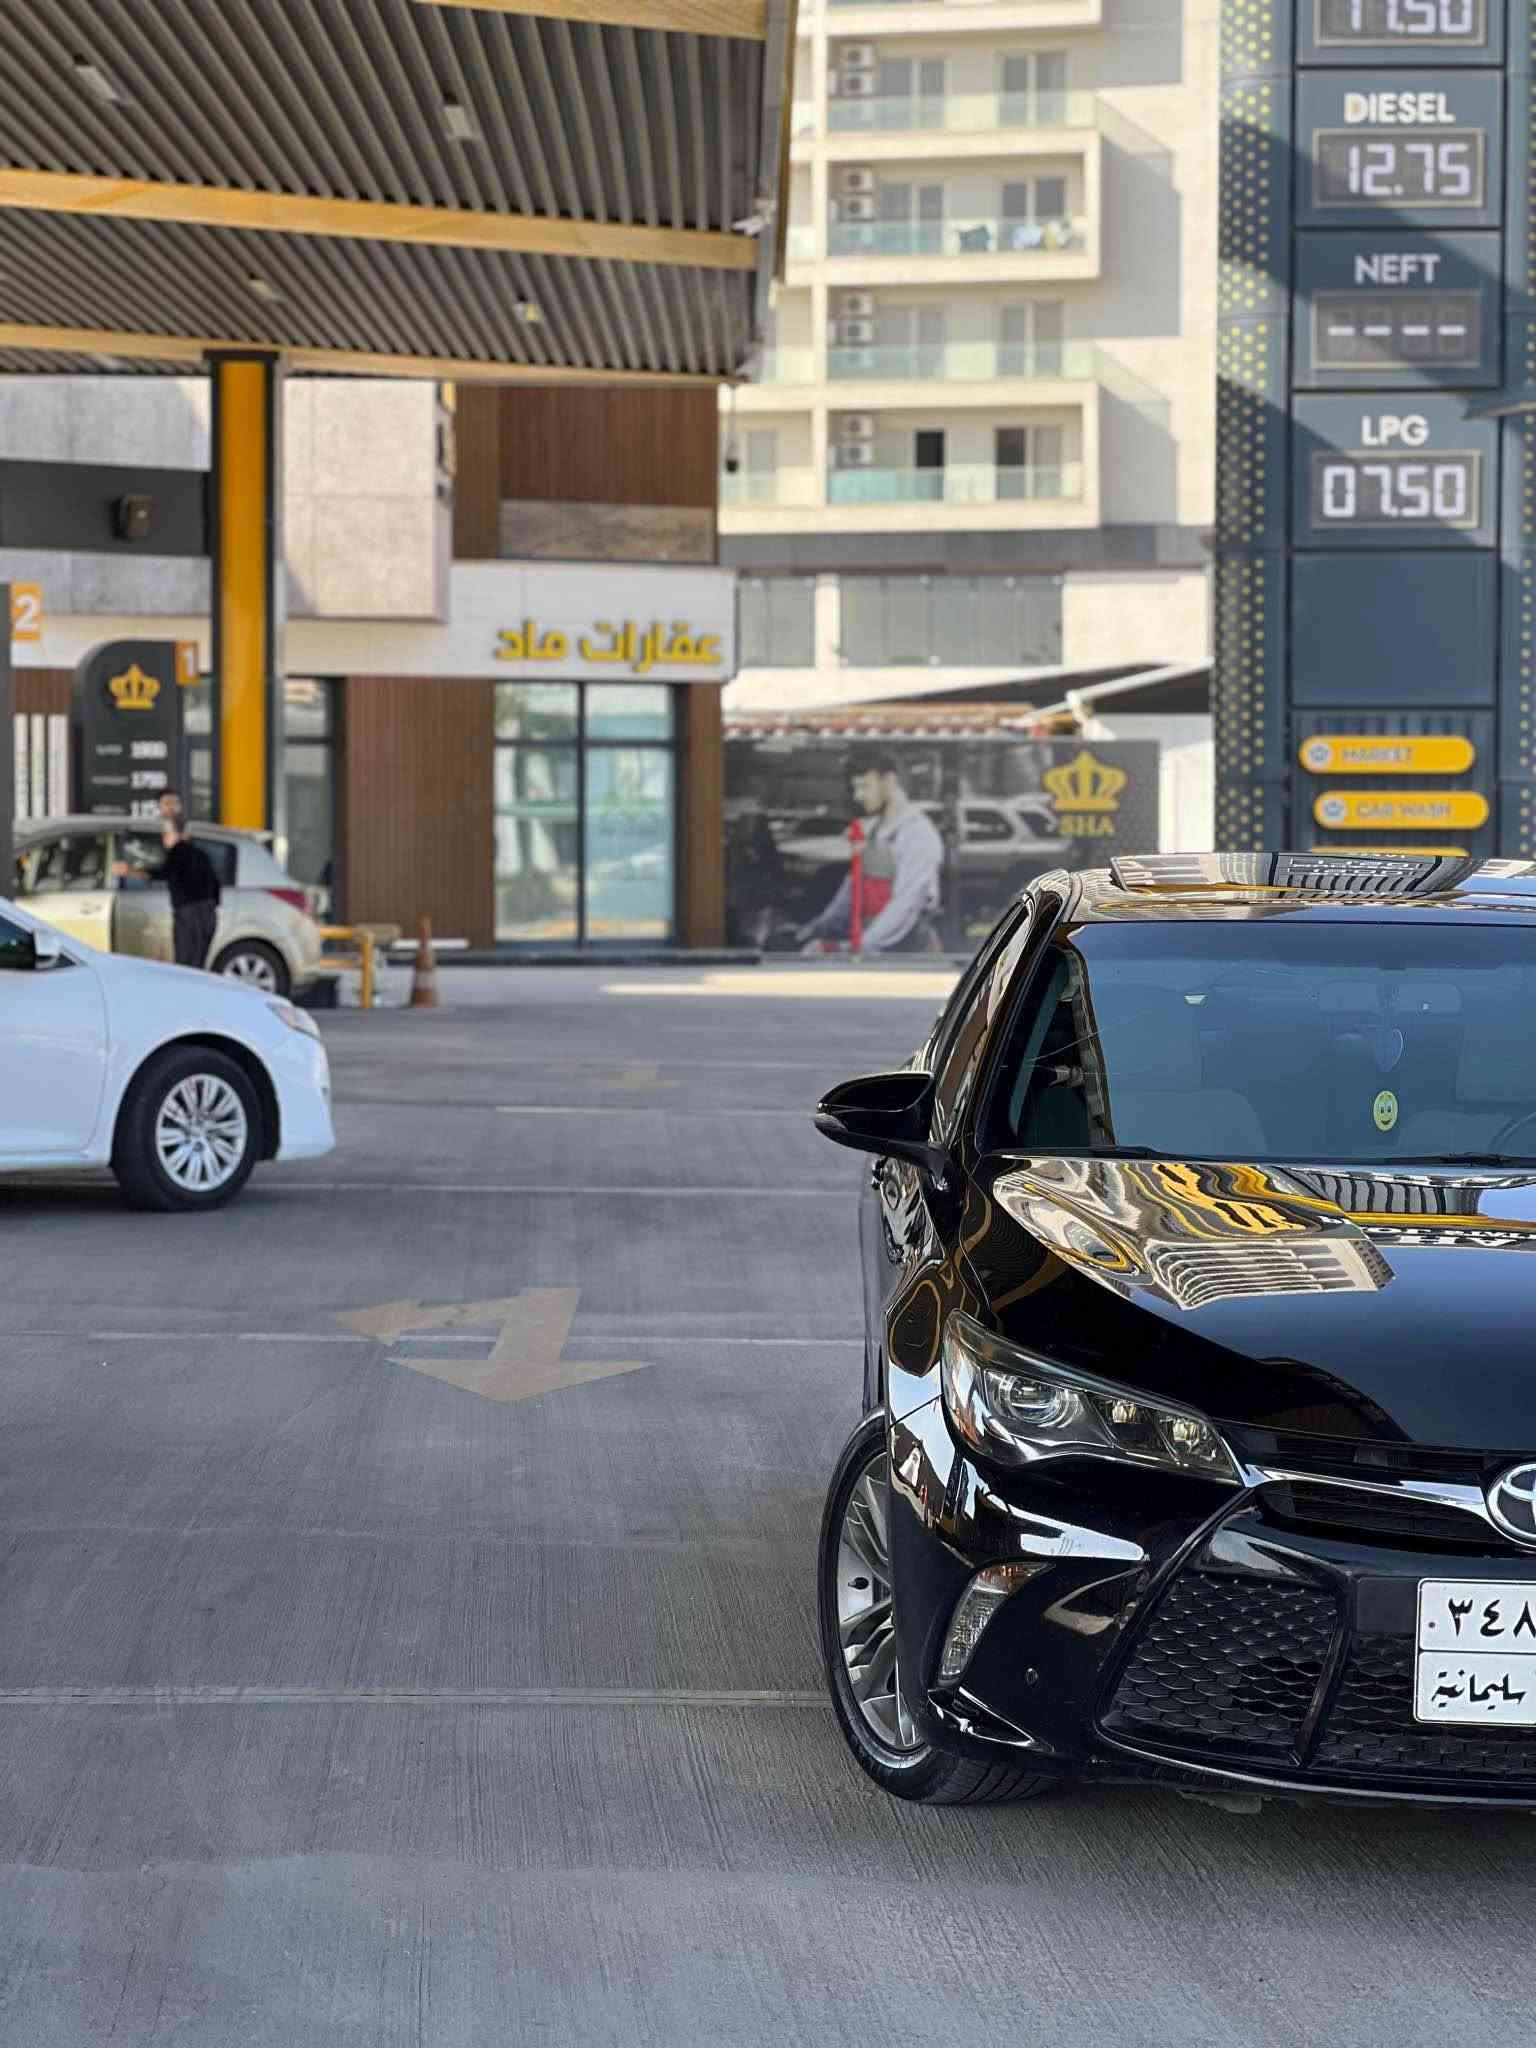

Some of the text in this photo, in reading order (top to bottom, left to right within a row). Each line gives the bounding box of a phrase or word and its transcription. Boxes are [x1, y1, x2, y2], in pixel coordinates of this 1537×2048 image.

[1344, 92, 1456, 123] DIESEL
[1348, 143, 1471, 196] 12.75
[1354, 254, 1441, 285] NEFT
[1361, 414, 1430, 447] LPG
[13, 594, 40, 632] 2
[180, 648, 196, 677] 1
[578, 620, 723, 672] عقارات
[1448, 1598, 1536, 1638] ٣٤٨
[1431, 1669, 1527, 1711] سليمانية
